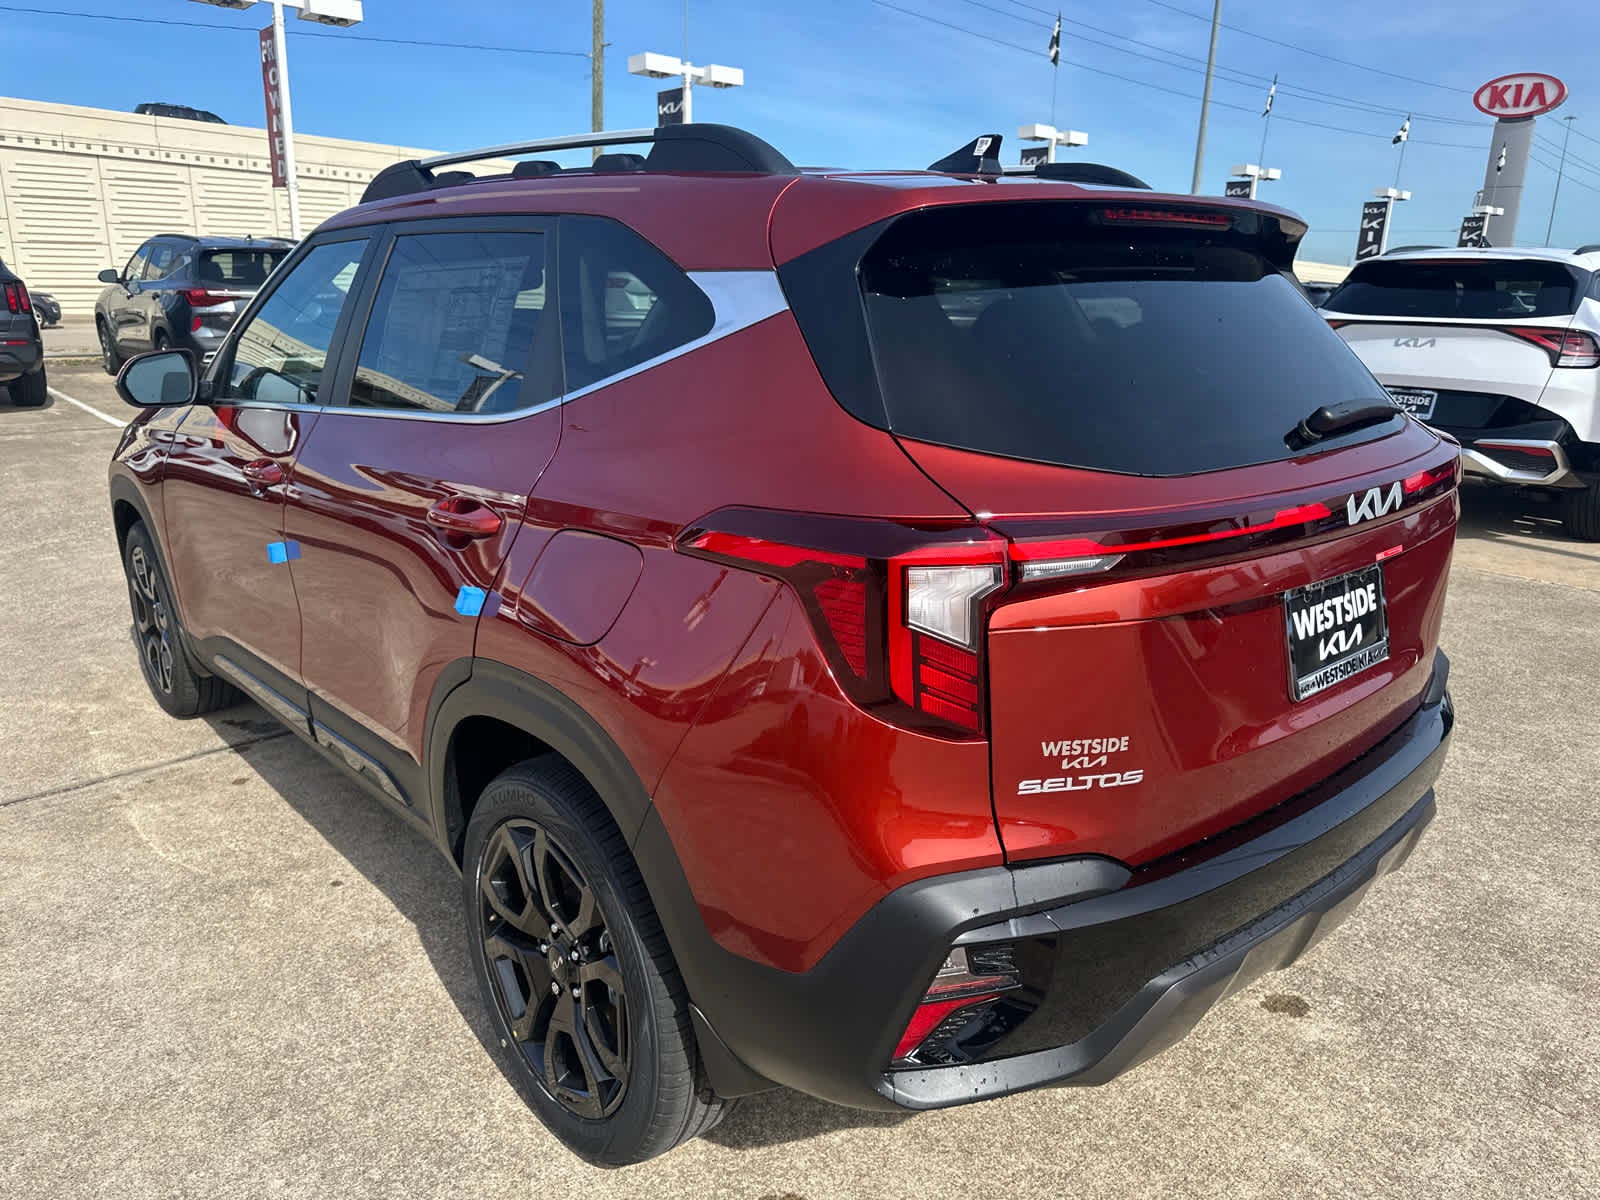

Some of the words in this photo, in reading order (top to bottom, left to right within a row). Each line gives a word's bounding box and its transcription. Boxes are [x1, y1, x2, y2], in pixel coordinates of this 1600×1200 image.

[1488, 82, 1547, 109] KIA
[1359, 218, 1384, 255] KIA
[1393, 336, 1437, 348] KIA
[1392, 395, 1431, 406] ESTSIDE
[1346, 481, 1403, 526] KIA
[1292, 582, 1377, 641] WESTSIDE
[1319, 623, 1363, 661] KIA
[1314, 660, 1357, 690] WESTSIDE
[1358, 650, 1374, 668] KIA
[1041, 736, 1130, 757] WESTSIDE
[1061, 755, 1108, 770] KIA
[1017, 769, 1144, 795] SELTOS
